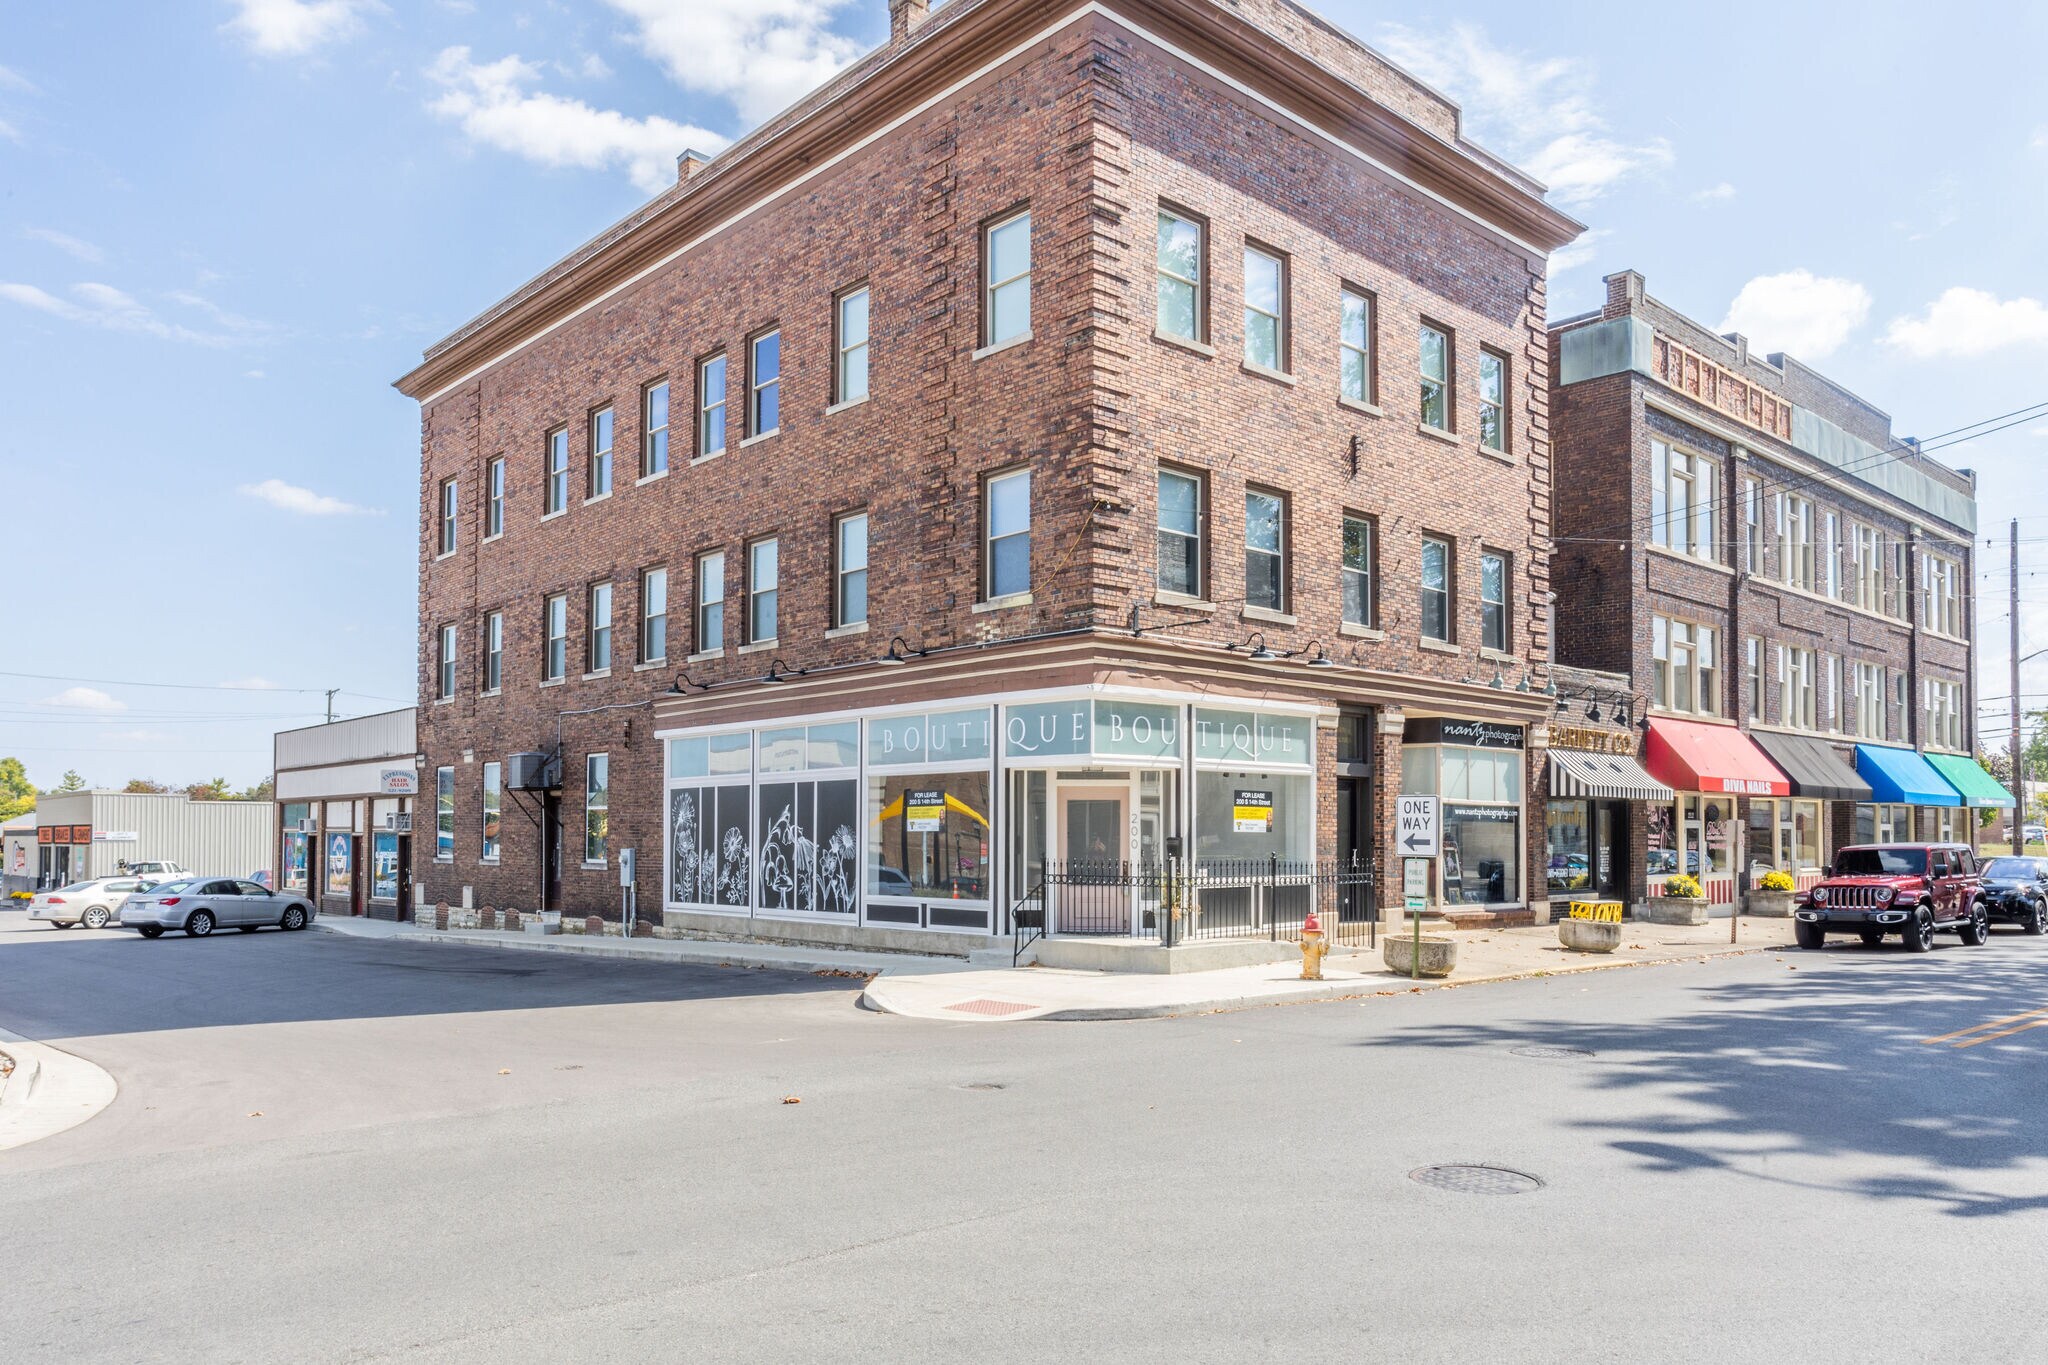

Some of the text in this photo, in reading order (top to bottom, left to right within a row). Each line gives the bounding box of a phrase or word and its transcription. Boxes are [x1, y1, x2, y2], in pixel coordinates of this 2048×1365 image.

[883, 712, 1085, 752] BOUTIQUE
[1110, 713, 1293, 758] BOUTIQUE
[1485, 725, 1523, 746] photograph
[1549, 725, 1609, 751] BARNETT
[382, 770, 416, 781] EXPRESSIONS
[1723, 778, 1772, 795] DIVA NAILS
[1403, 800, 1430, 814] ONE
[1402, 817, 1431, 831] WAY
[1408, 868, 1424, 876] PUBLIC
[1407, 878, 1424, 886] PARKING
